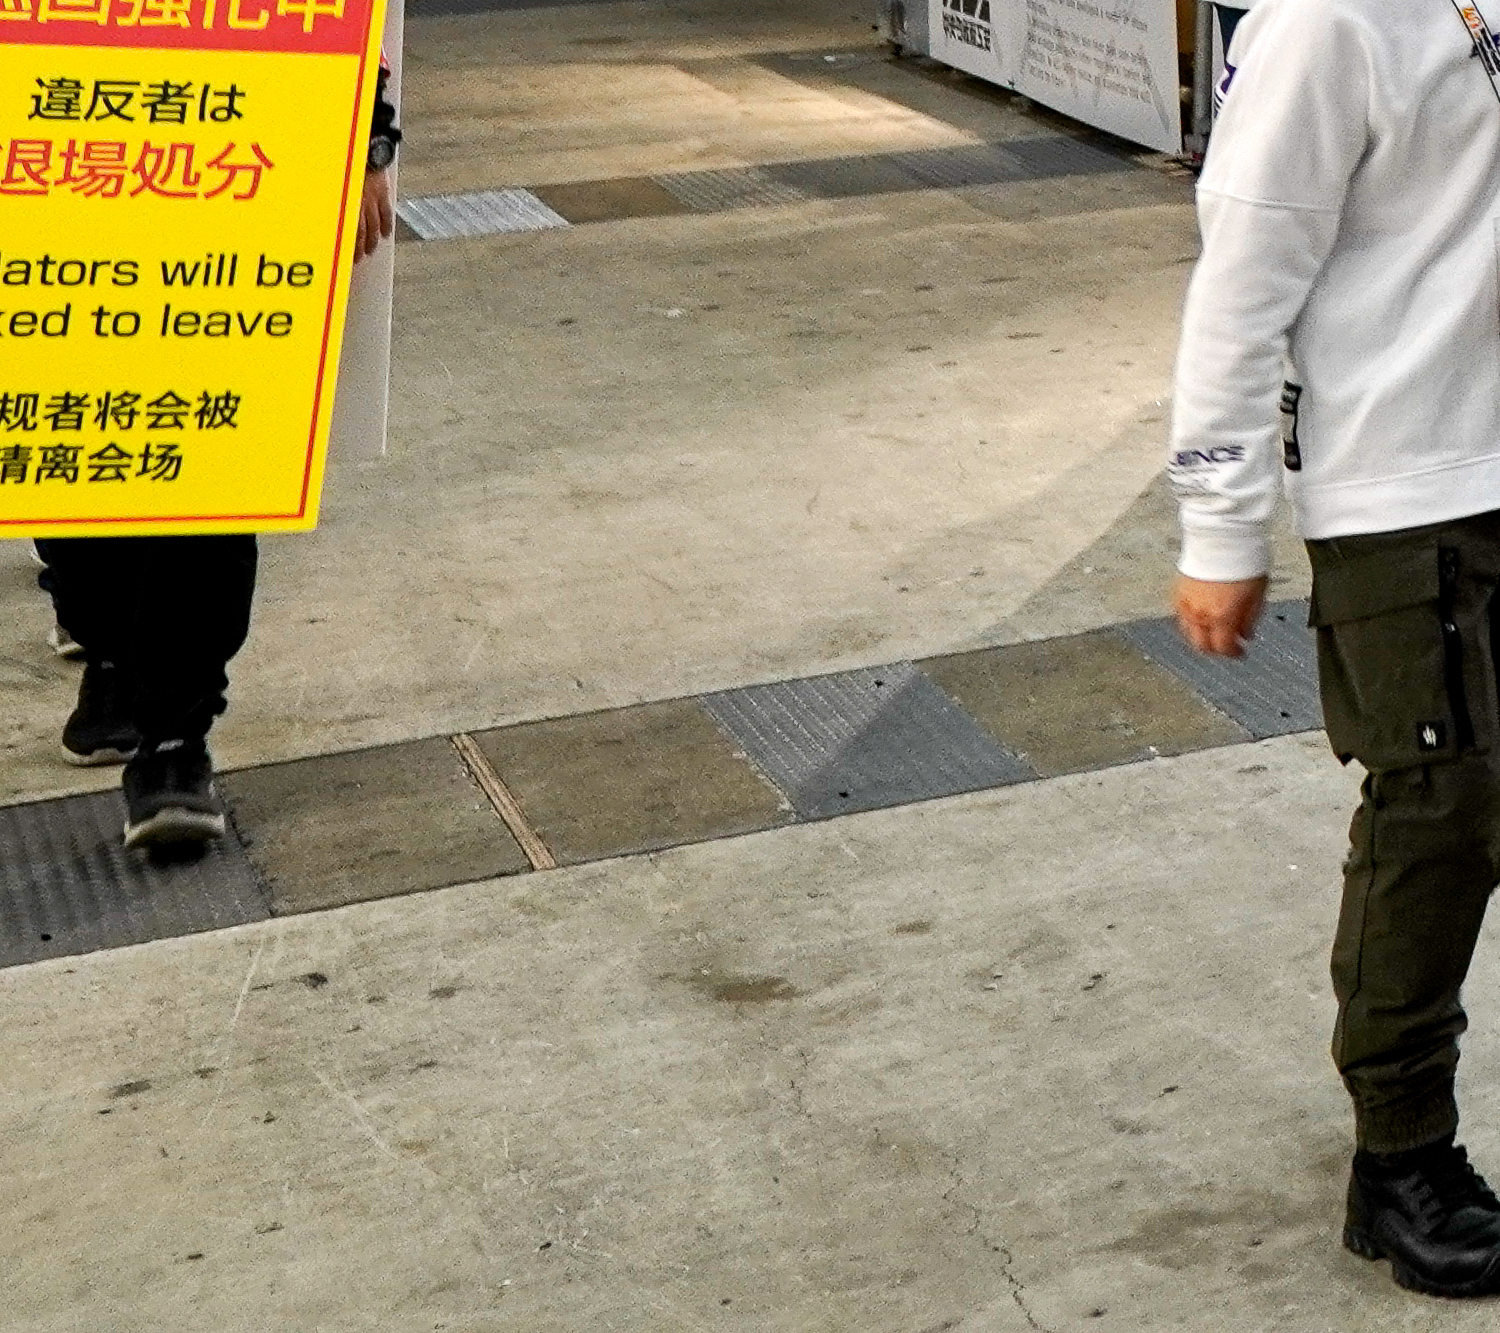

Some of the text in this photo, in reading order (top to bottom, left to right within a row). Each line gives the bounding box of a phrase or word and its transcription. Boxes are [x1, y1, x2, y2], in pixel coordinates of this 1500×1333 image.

[28, 76, 246, 125] 違反者は
[160, 253, 238, 288] will
[256, 254, 315, 289] be
[92, 306, 142, 338] to
[161, 304, 294, 338] leave
